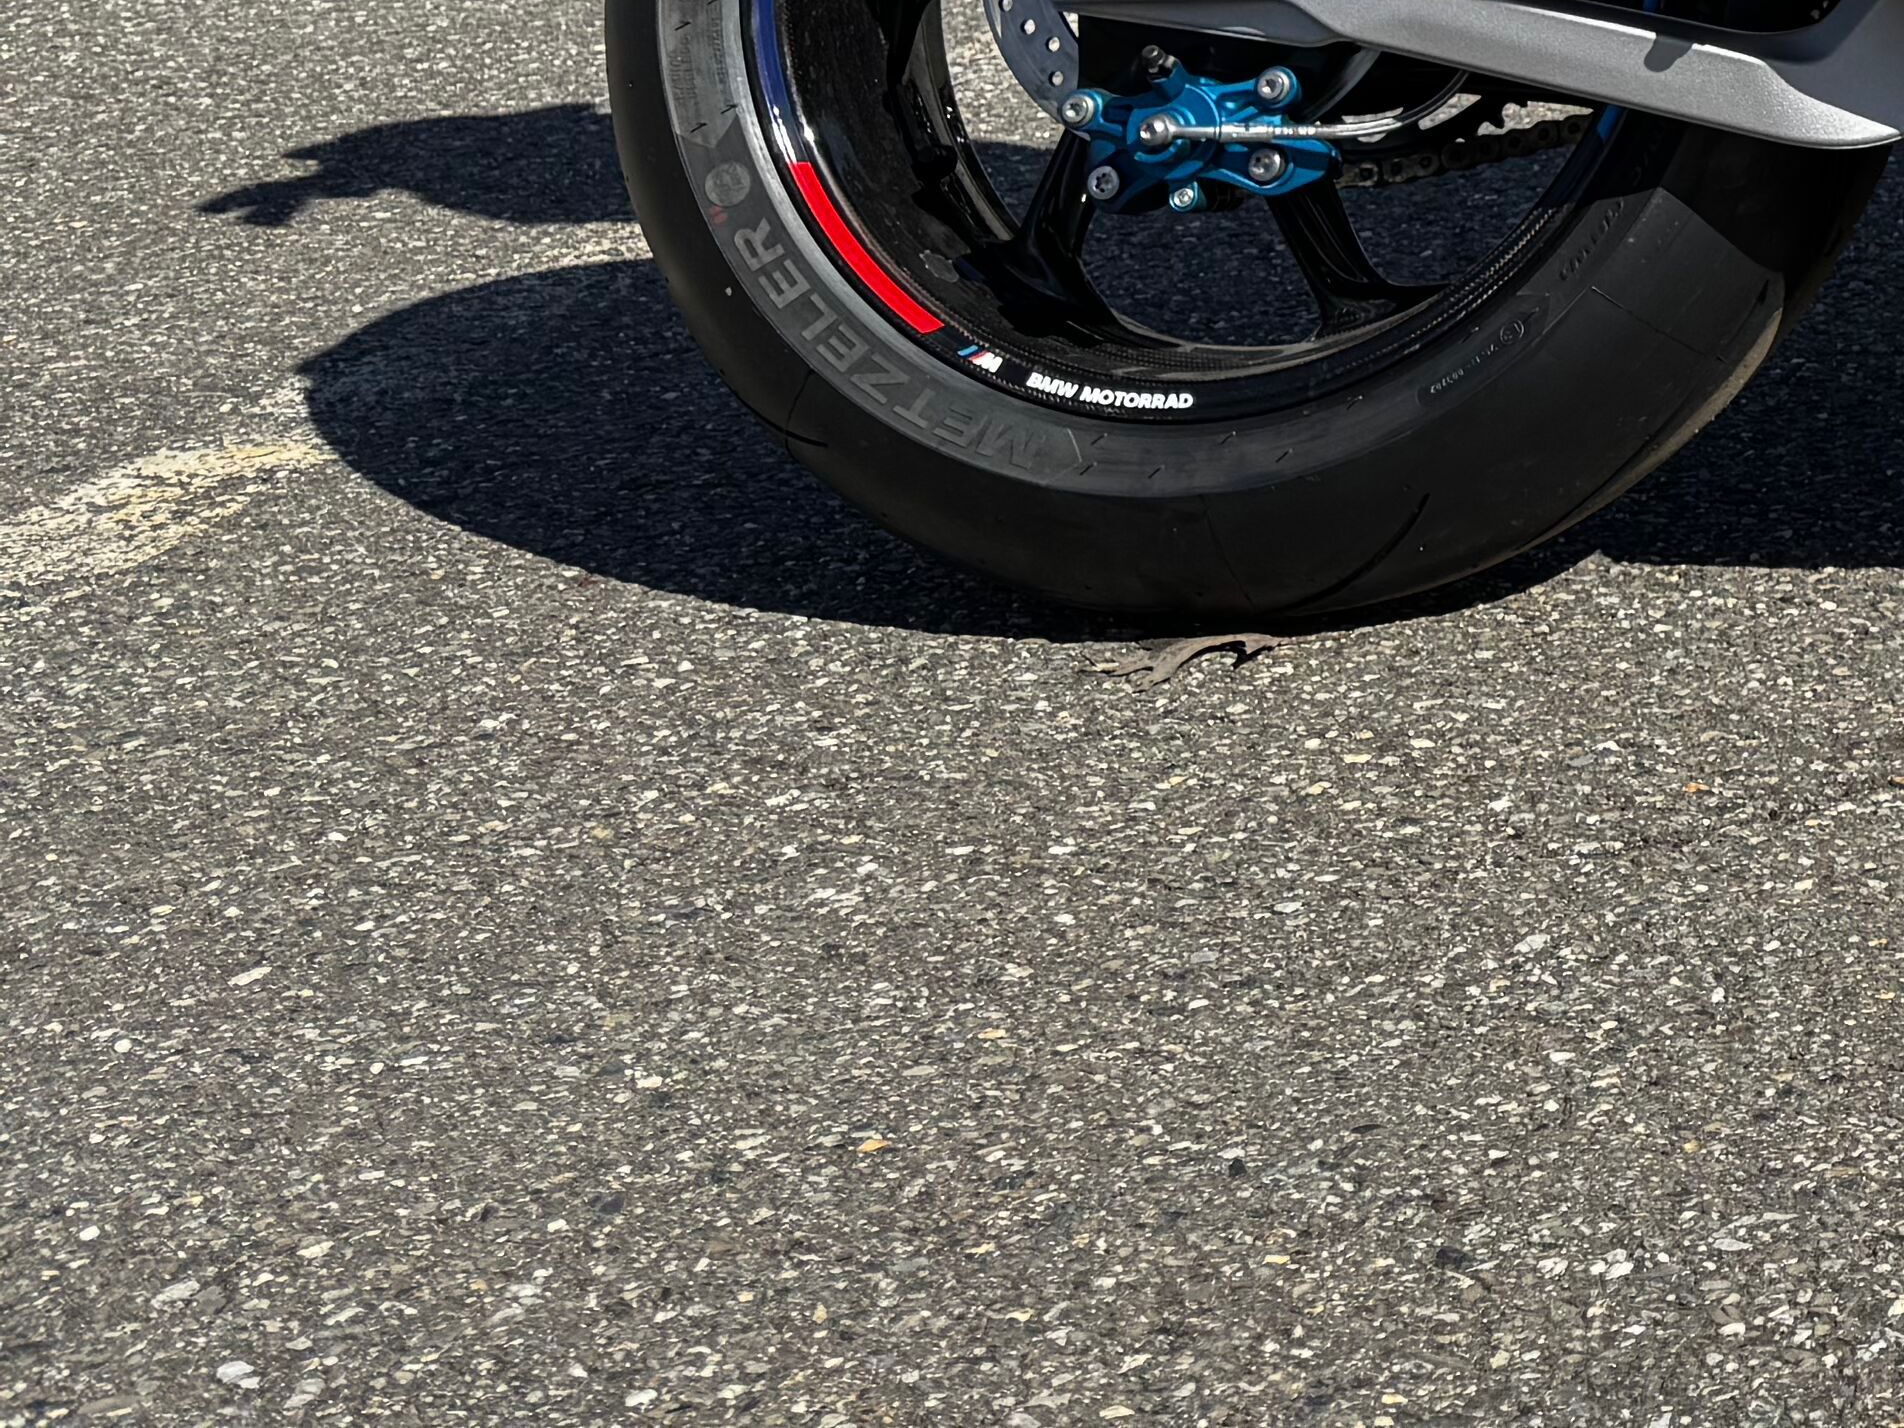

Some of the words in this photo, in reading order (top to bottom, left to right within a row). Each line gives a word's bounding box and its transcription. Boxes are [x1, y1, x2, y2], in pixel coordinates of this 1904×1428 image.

[733, 216, 1042, 472] METZELER
[1025, 371, 1080, 399] BMW
[1079, 385, 1195, 410] MOTORRAD
